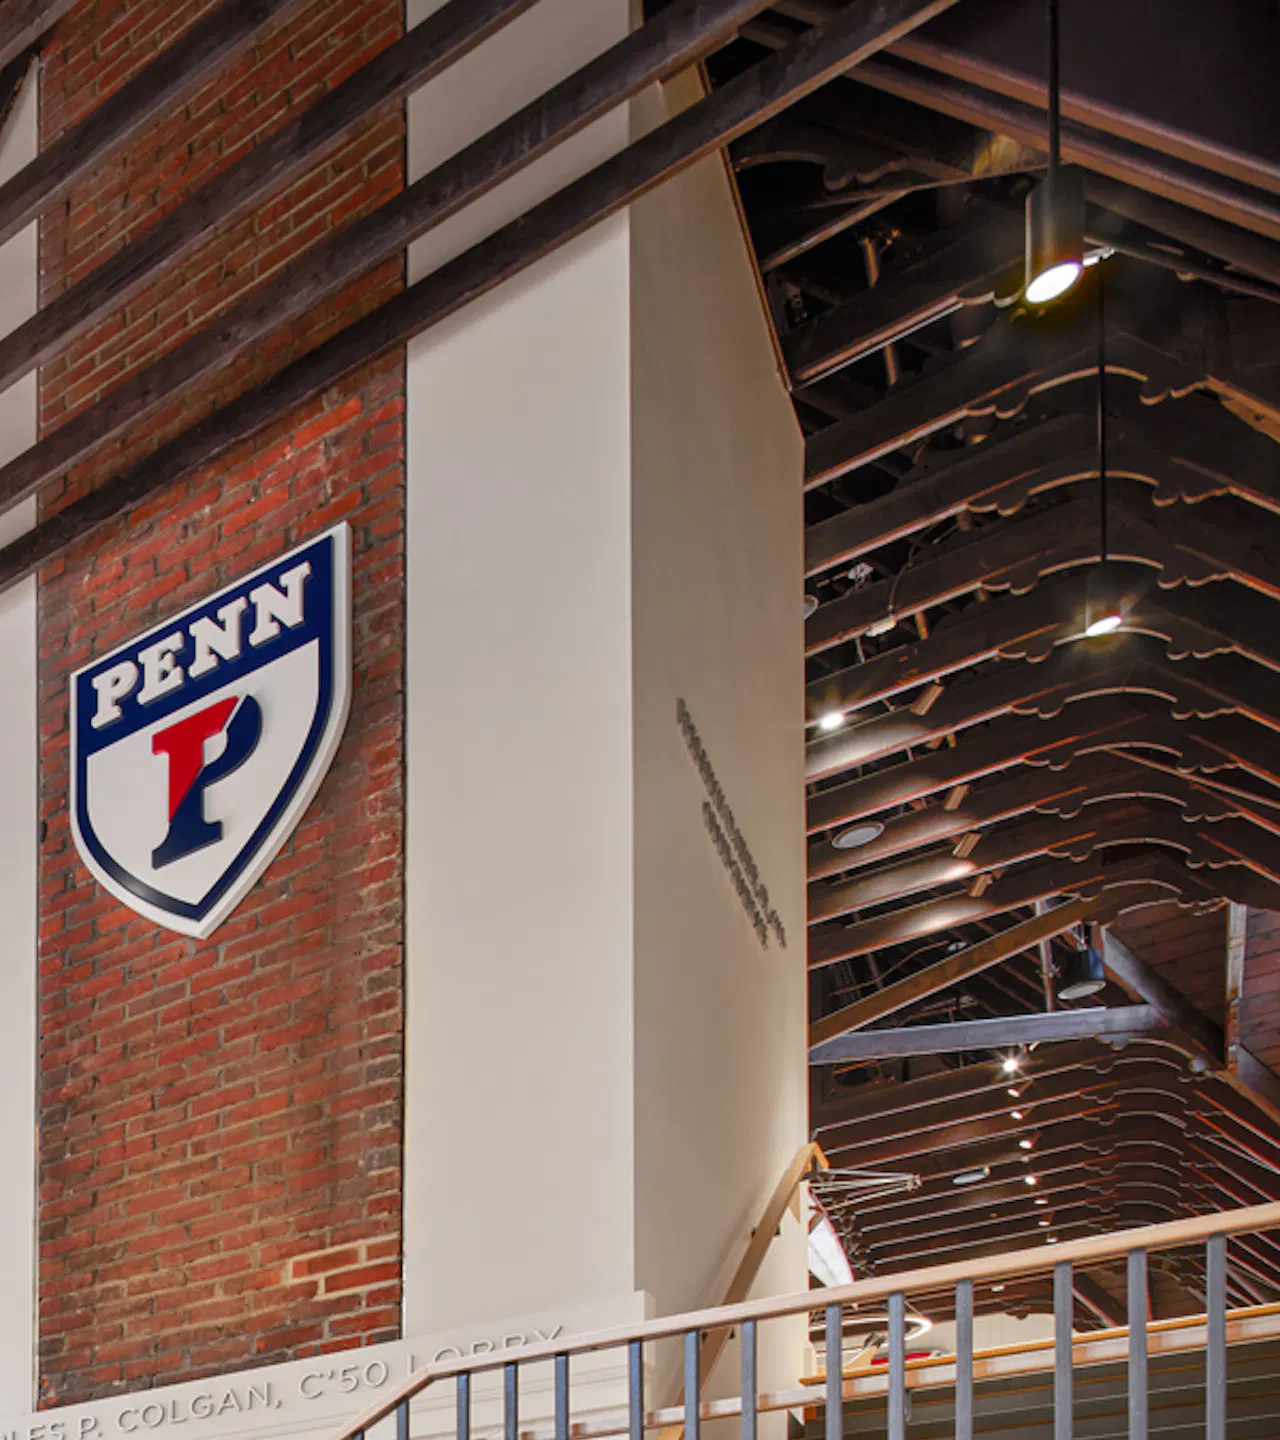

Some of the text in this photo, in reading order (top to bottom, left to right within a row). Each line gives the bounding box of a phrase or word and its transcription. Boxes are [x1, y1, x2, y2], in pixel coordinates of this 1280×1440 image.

[90, 561, 312, 730] PENN
[152, 694, 263, 870] P
[115, 1380, 284, 1434] COLGAN,
